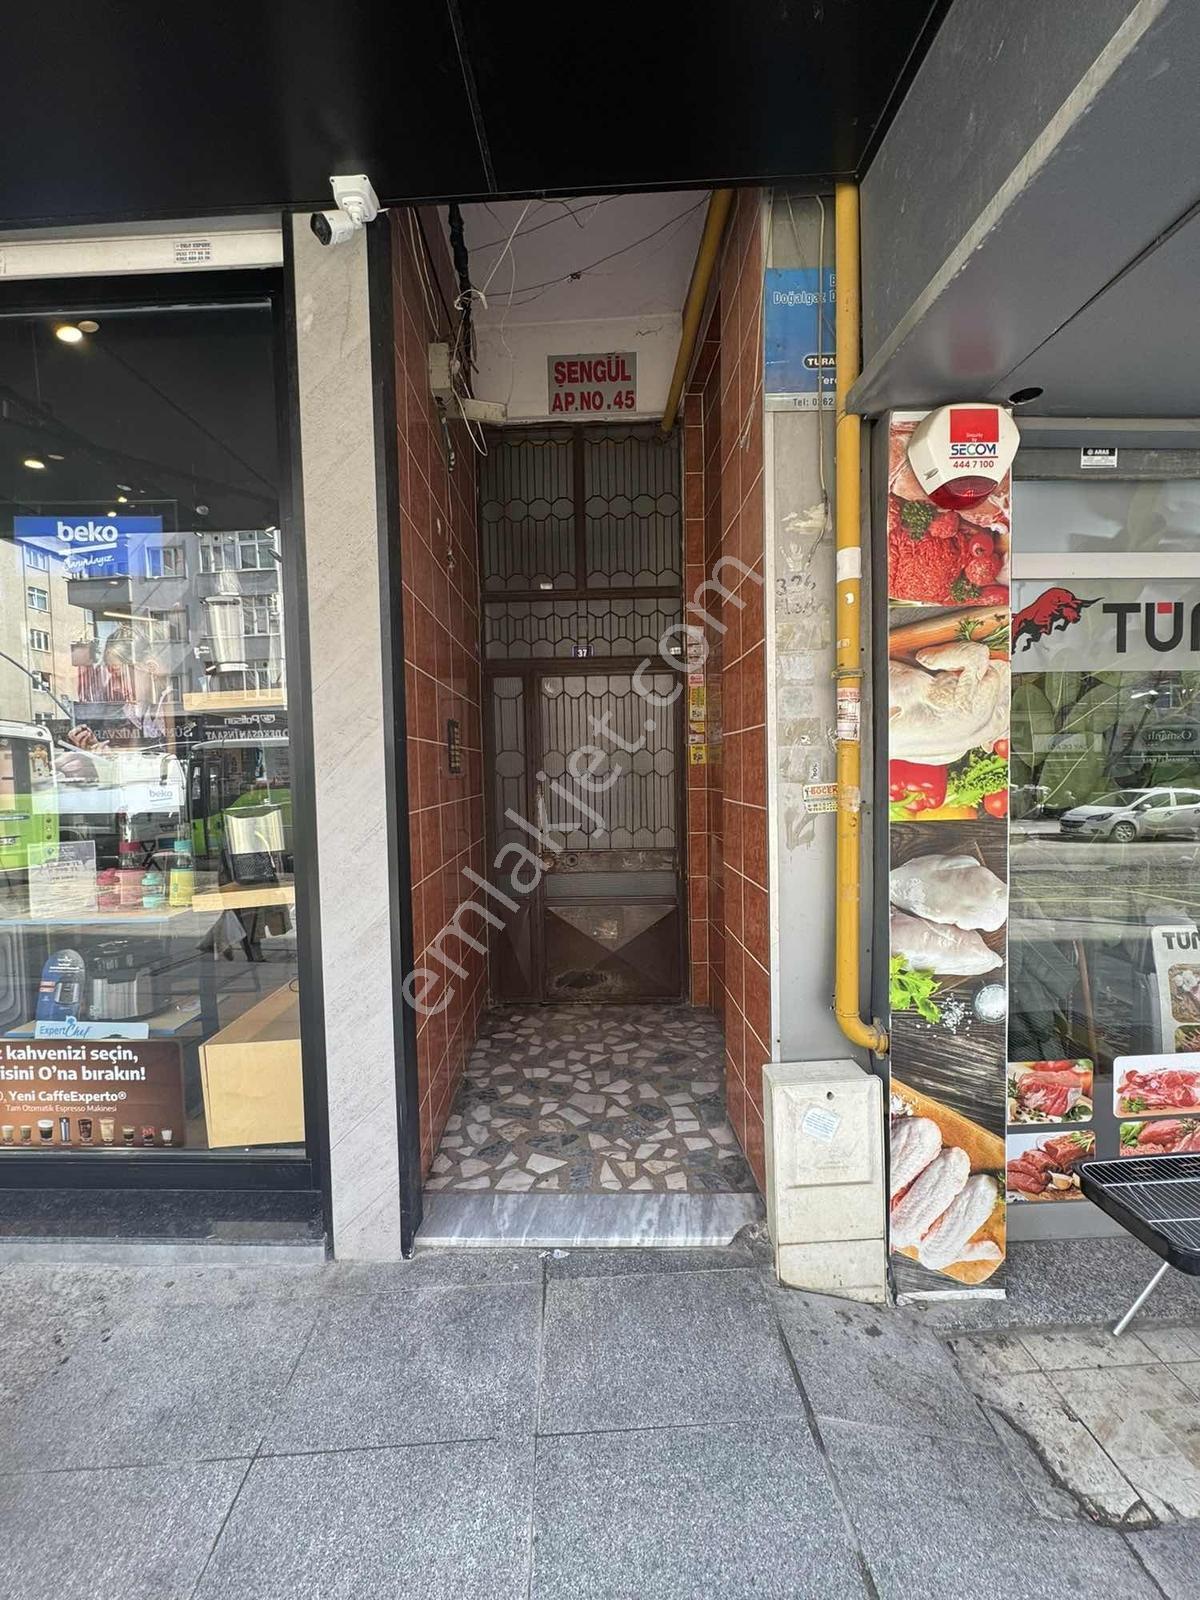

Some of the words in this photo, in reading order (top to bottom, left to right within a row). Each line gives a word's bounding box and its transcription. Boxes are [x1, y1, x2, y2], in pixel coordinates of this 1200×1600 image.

[793, 398, 809, 407] Tel:
[951, 443, 997, 456] SECOM
[953, 460, 970, 468] 444
[972, 460, 978, 468] 7
[980, 460, 995, 468] 100
[57, 521, 119, 542] beko
[1103, 602, 1200, 653] TÜ
[577, 649, 588, 657] 37
[6, 1045, 87, 1061] kahvenizi
[90, 1045, 139, 1064] seçin,
[81, 1066, 147, 1081] bırakın!
[9, 1090, 36, 1102] Yeni
[6, 1105, 22, 1113] Tam
[22, 1104, 54, 1113] Otomatik
[54, 1105, 87, 1114] Espresso
[86, 1104, 118, 1113] Makinesi
